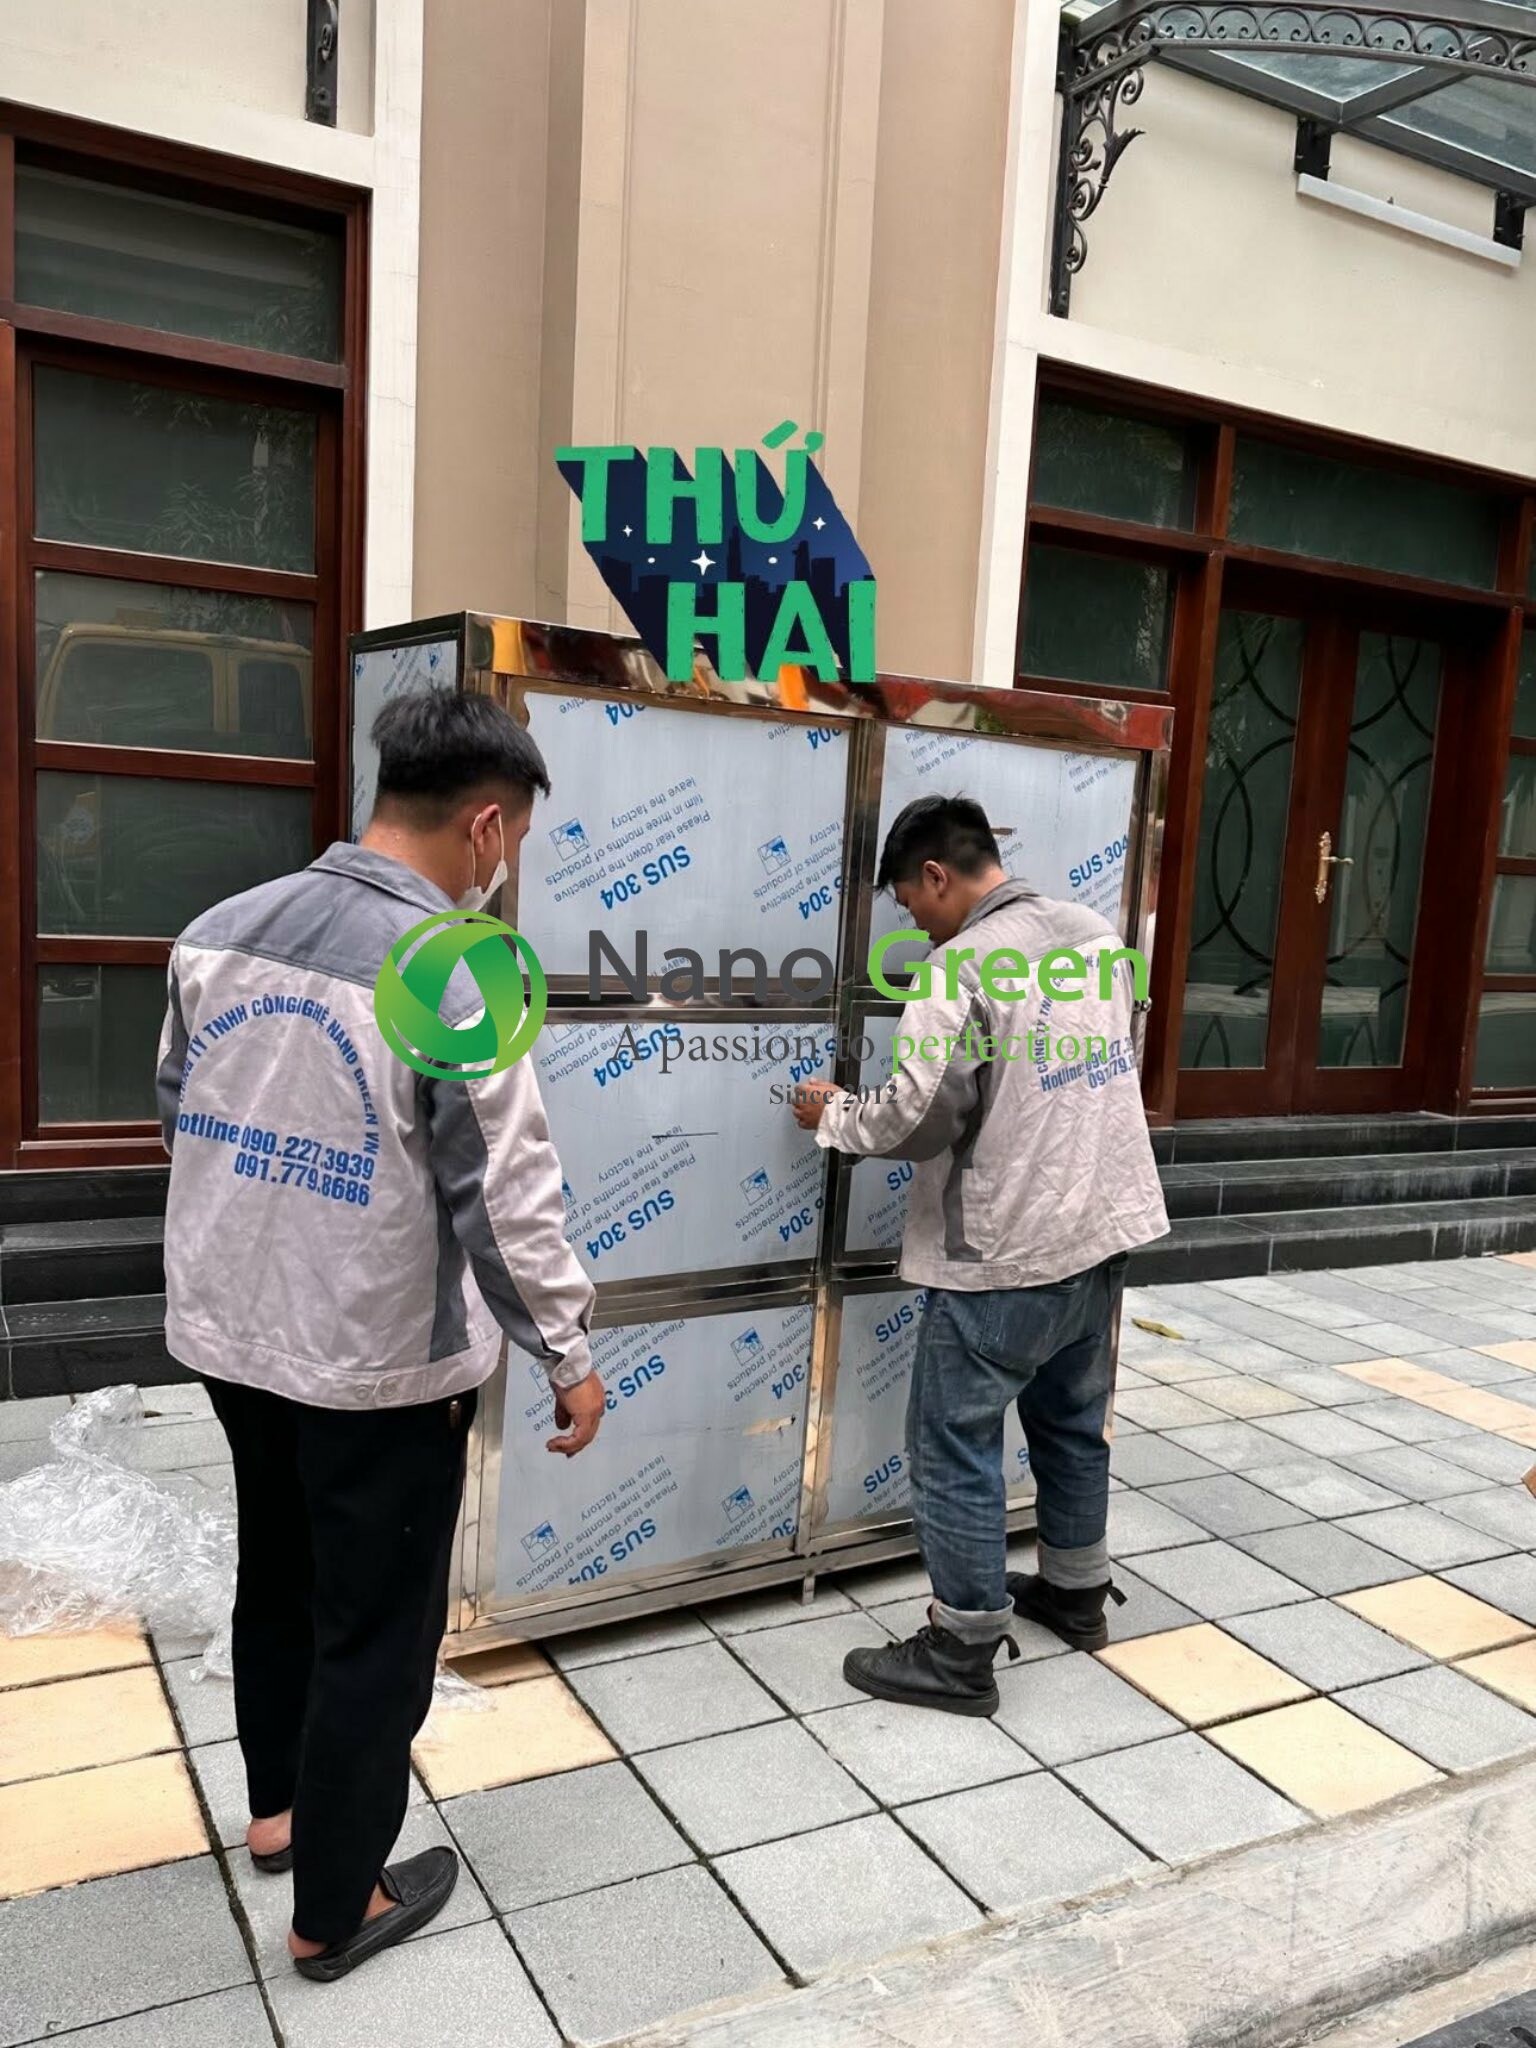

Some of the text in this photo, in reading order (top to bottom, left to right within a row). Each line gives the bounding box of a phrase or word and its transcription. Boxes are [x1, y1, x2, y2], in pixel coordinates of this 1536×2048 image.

[606, 703, 645, 725] 04
[807, 728, 841, 750] 04
[917, 747, 955, 775] leave the
[611, 776, 696, 829] leave the factory
[545, 794, 704, 886] film in three months of products
[810, 821, 840, 845] factory
[555, 810, 711, 902] Please tear down the protective
[1002, 842, 1023, 859] ducts
[1069, 834, 1130, 887] SUS 304
[601, 846, 690, 910] SUS 304
[753, 842, 836, 898] months of products
[806, 871, 820, 885] the
[761, 880, 804, 913] protective
[799, 886, 832, 920] 304
[252, 993, 297, 1016] CÔNG
[202, 1005, 248, 1040] TNHH
[189, 1035, 207, 1057] TY
[327, 1018, 358, 1064] NANO
[540, 1028, 596, 1068] of products
[549, 1036, 618, 1083] the protective
[594, 1050, 633, 1087] 304
[790, 1049, 823, 1083] 304
[354, 1067, 379, 1125] GREEN
[179, 1113, 240, 1144] otline
[363, 1132, 379, 1155] VN
[636, 1143, 653, 1158] the
[662, 1154, 695, 1179] Please
[581, 1139, 689, 1216] film in three months of
[599, 1156, 635, 1183] factory
[642, 1177, 661, 1194] tear
[887, 1162, 912, 1190] SU
[612, 1190, 639, 1212] down
[736, 1165, 818, 1229] months of products
[786, 1196, 800, 1209] the
[868, 1201, 897, 1223] Please
[566, 1222, 593, 1243] prote
[587, 1190, 675, 1260] SUS 304
[595, 1210, 611, 1224] the
[742, 1207, 785, 1241] protective
[779, 1207, 813, 1242] 304
[873, 1216, 899, 1236] film in
[876, 1305, 913, 1342] SUS
[602, 1319, 685, 1381] Please tear down
[727, 1323, 809, 1389] months of products
[857, 1352, 886, 1376] Please
[887, 1339, 902, 1355] tear
[525, 1327, 648, 1418] three ducts
[619, 1354, 665, 1398] SUS
[734, 1354, 793, 1402] the protective
[772, 1364, 805, 1399] 304
[862, 1375, 878, 1389] film
[879, 1367, 887, 1376] in
[888, 1350, 910, 1369] three
[868, 1370, 905, 1402] leave the
[580, 1454, 665, 1521] leave the factory
[773, 1460, 799, 1485] actory
[864, 1455, 902, 1493] SUS
[577, 1481, 678, 1561] Please tear down the
[757, 1505, 767, 1515] of
[769, 1509, 782, 1521] the
[516, 1468, 671, 1588] film in three months of products
[610, 1518, 656, 1562] SUS
[716, 1513, 755, 1545] products
